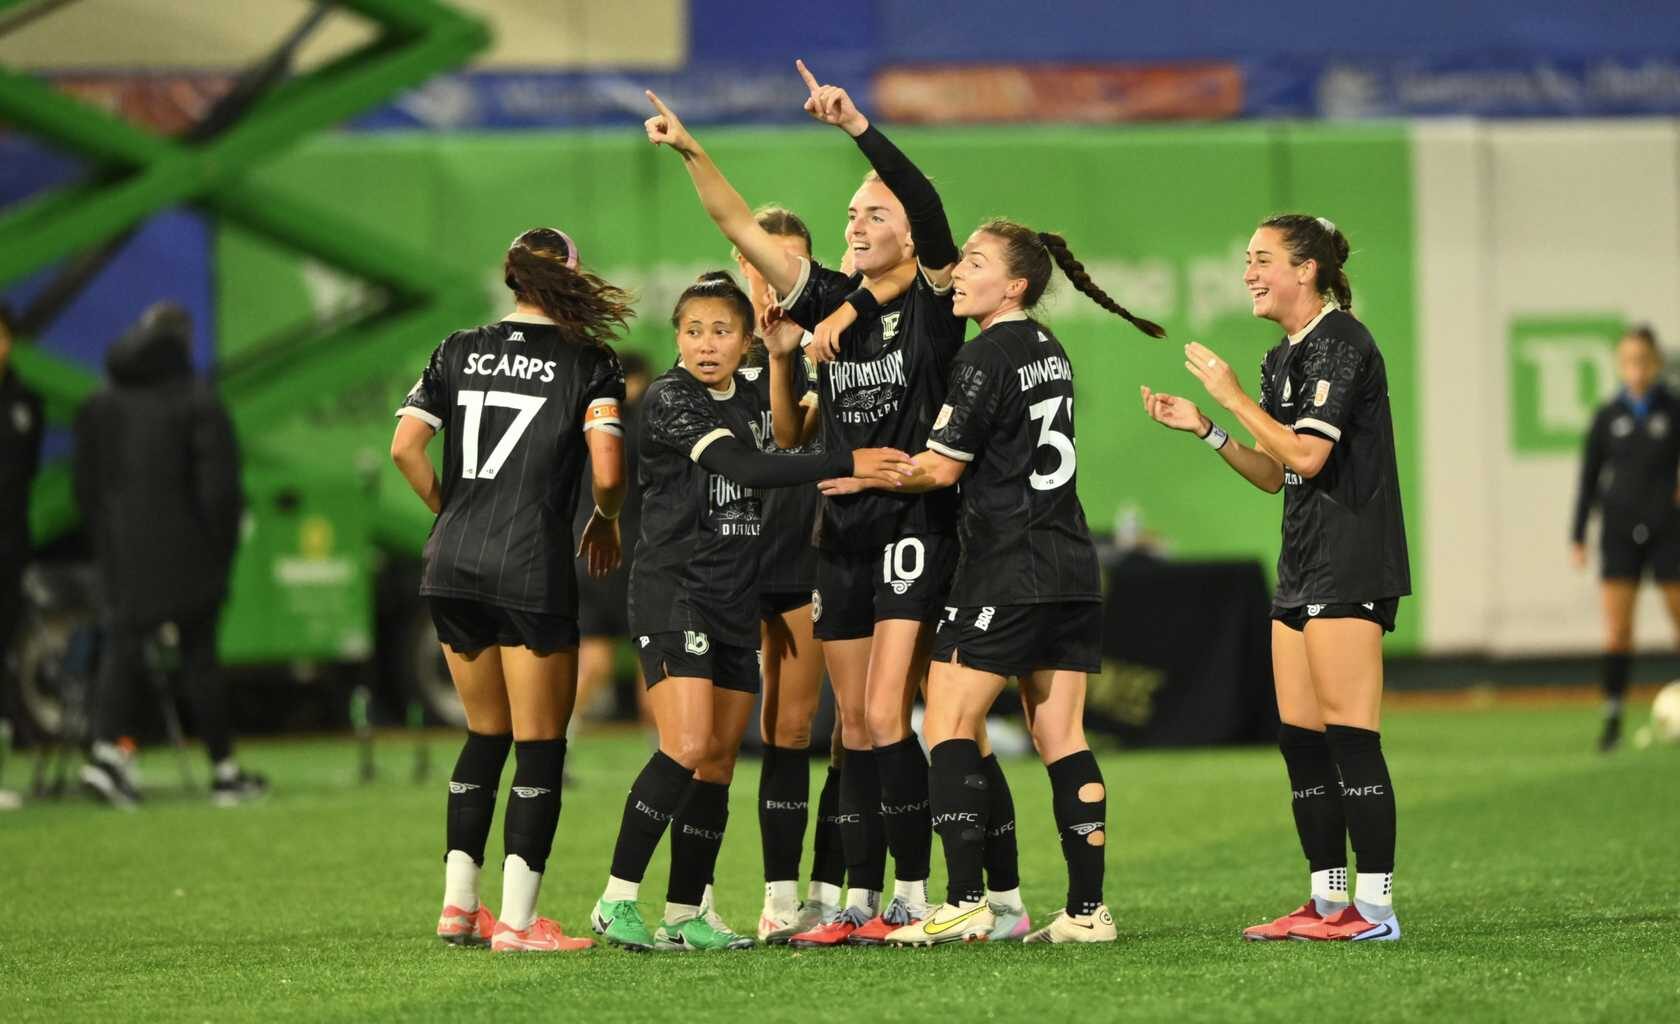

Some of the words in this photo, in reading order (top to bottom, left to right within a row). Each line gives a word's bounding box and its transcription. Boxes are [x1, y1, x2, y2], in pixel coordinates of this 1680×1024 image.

[463, 352, 557, 383] SCARPS
[457, 390, 548, 480] 17
[1029, 395, 1076, 491] 3
[883, 537, 925, 583] 10
